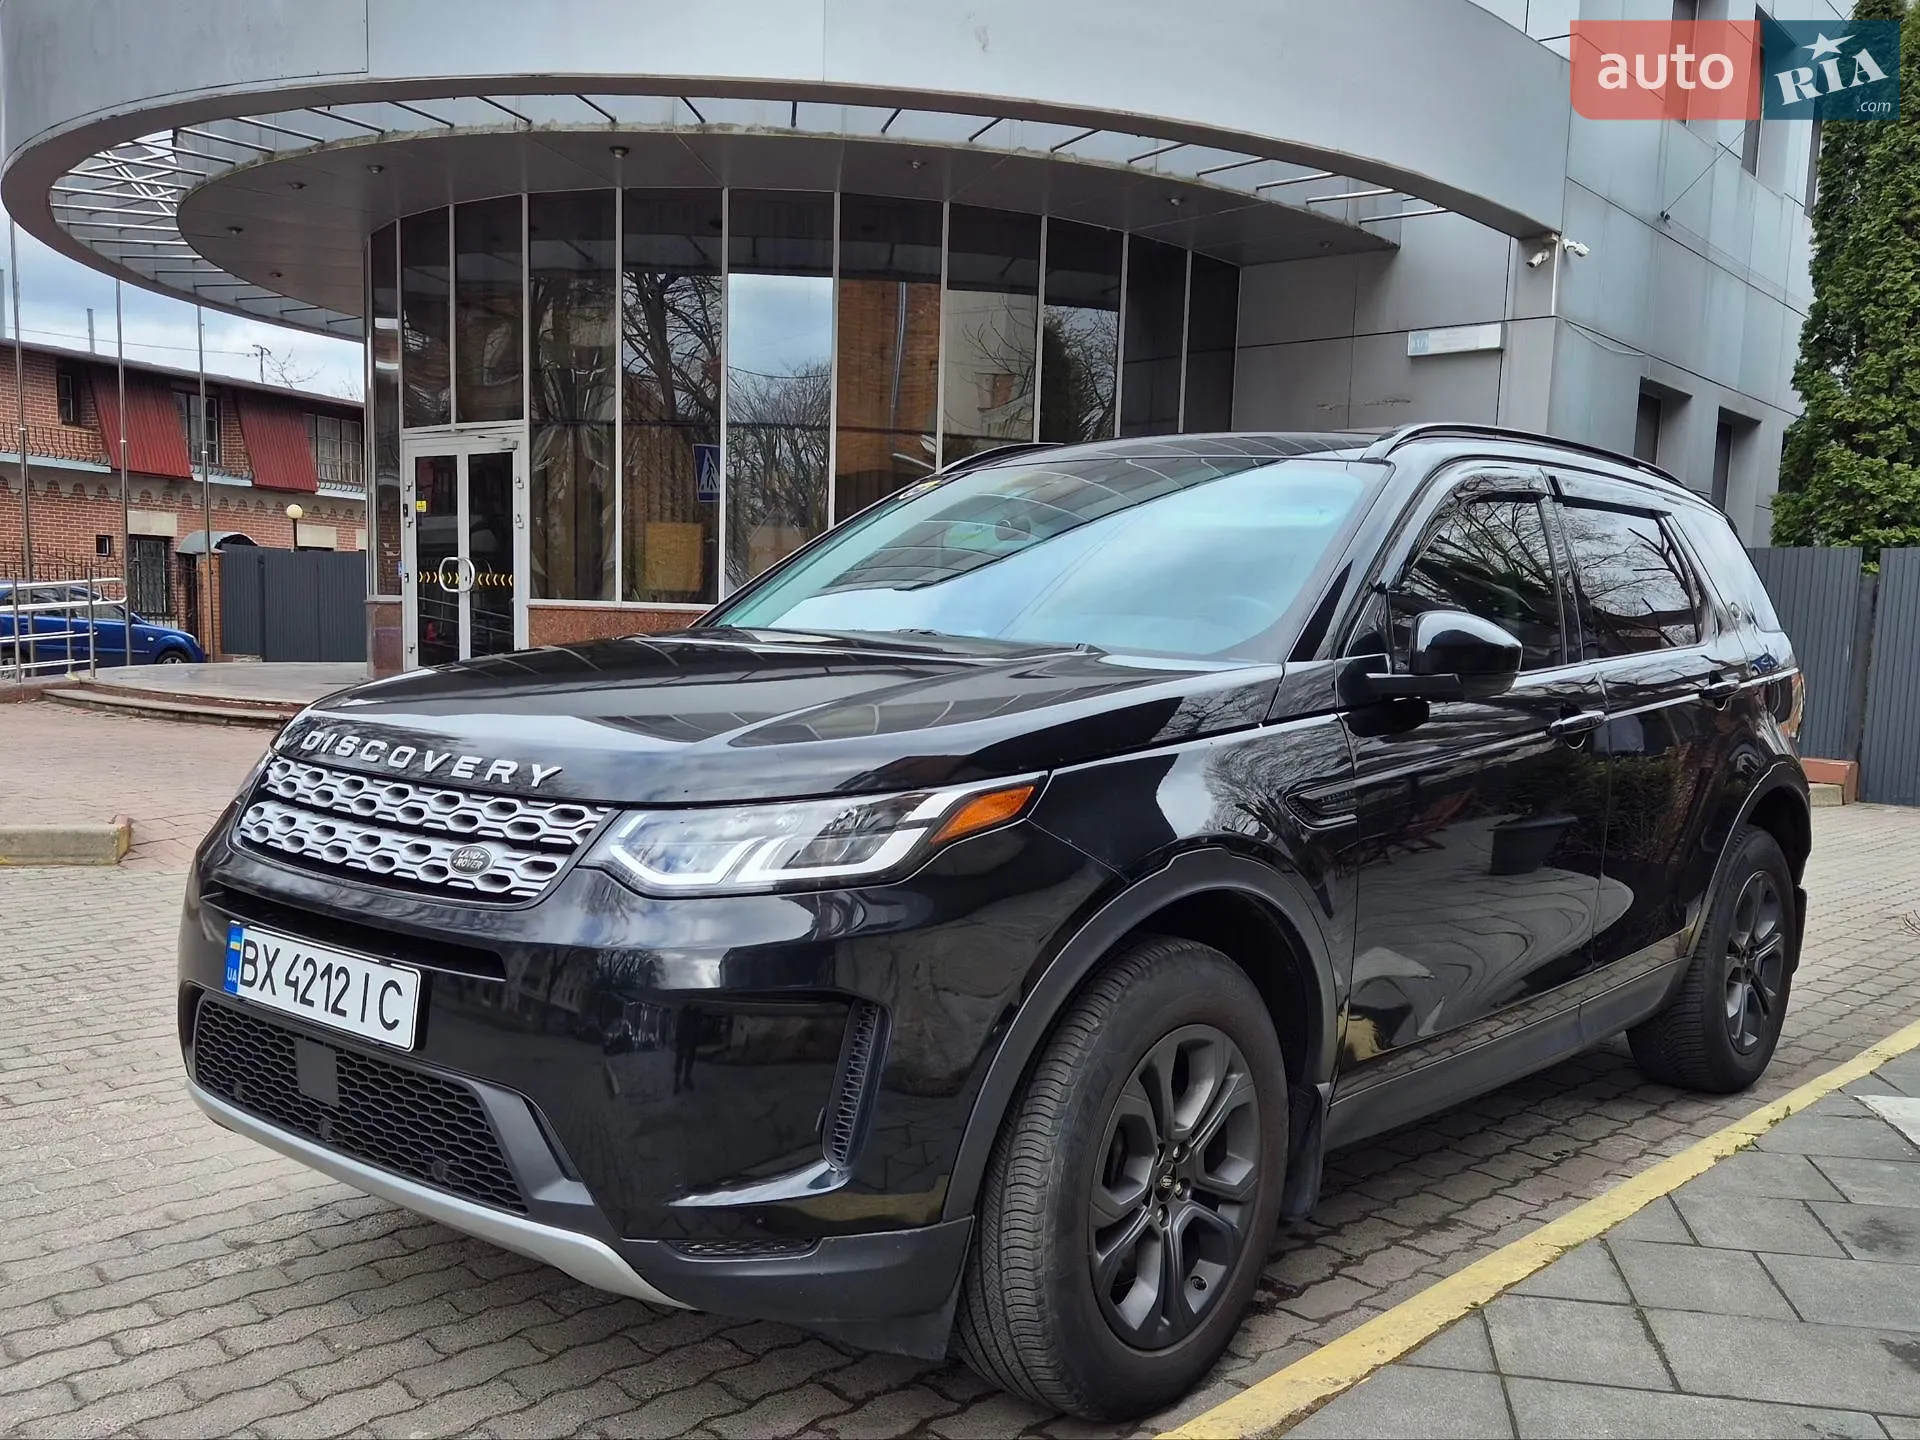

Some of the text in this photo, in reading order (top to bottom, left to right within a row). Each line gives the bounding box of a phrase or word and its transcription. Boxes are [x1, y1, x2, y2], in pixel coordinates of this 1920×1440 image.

[301, 730, 563, 788] DISCOVERY
[456, 858, 484, 870] ROVER
[227, 967, 238, 983] UA
[239, 938, 403, 1031] BX 4212 IC
